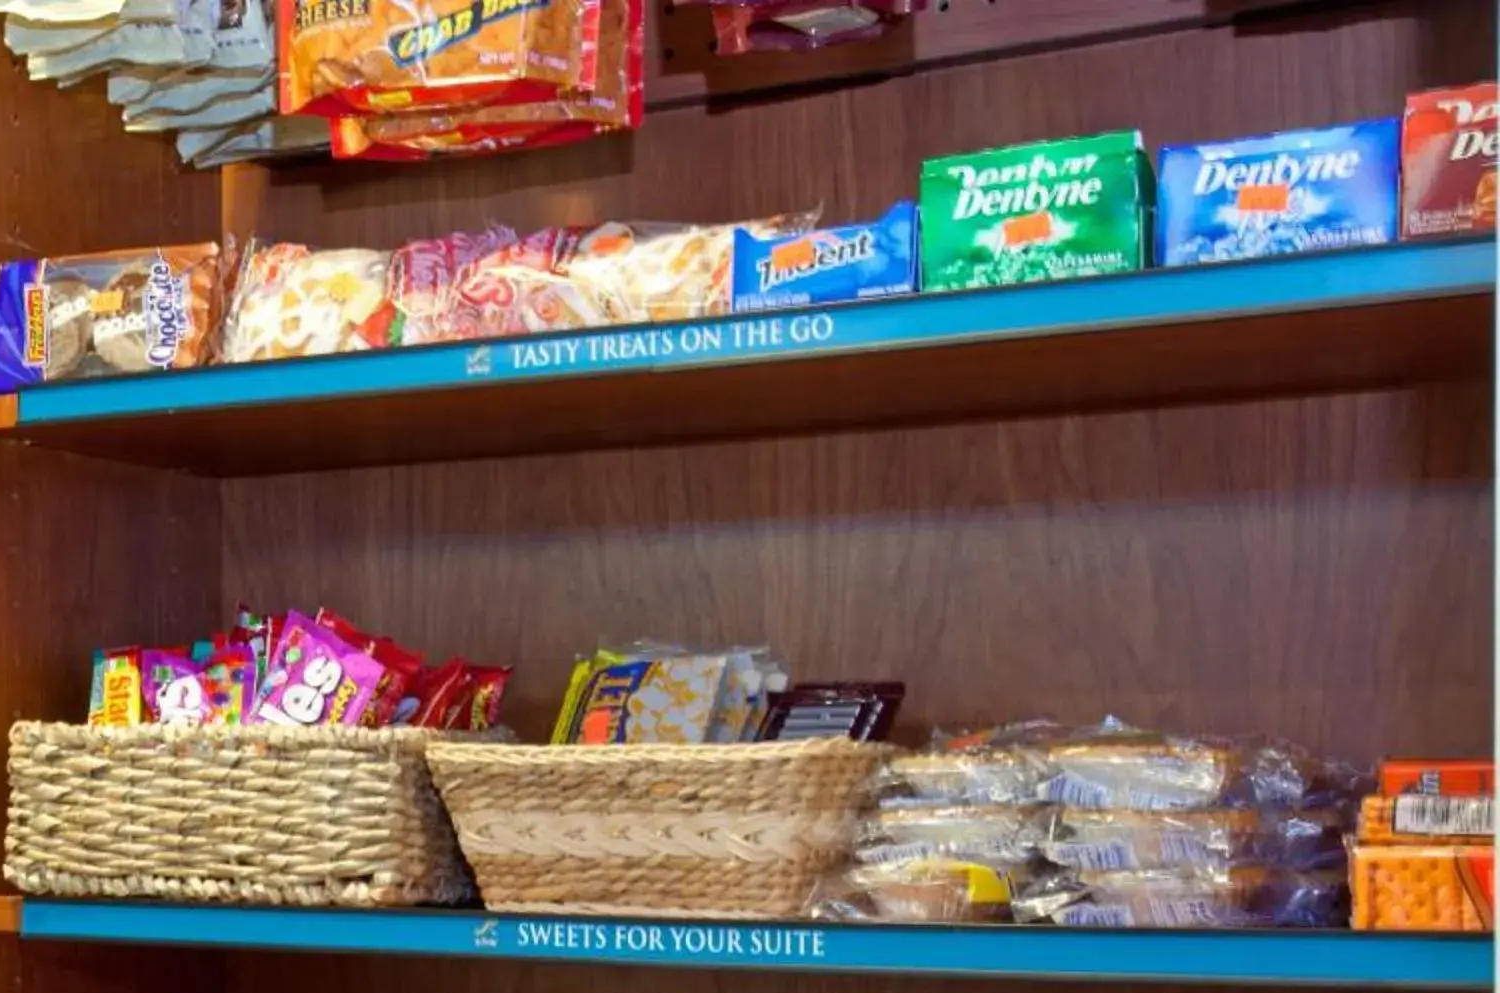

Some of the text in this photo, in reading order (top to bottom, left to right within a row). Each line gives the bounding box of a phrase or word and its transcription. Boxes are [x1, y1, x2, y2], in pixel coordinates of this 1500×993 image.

[1194, 150, 1360, 195] Dentyne
[953, 178, 1103, 219] Dentyne
[511, 313, 834, 370] TASTY TREATS ON THE GO
[517, 922, 824, 957] SWEETS FOR YOUR SUITE
